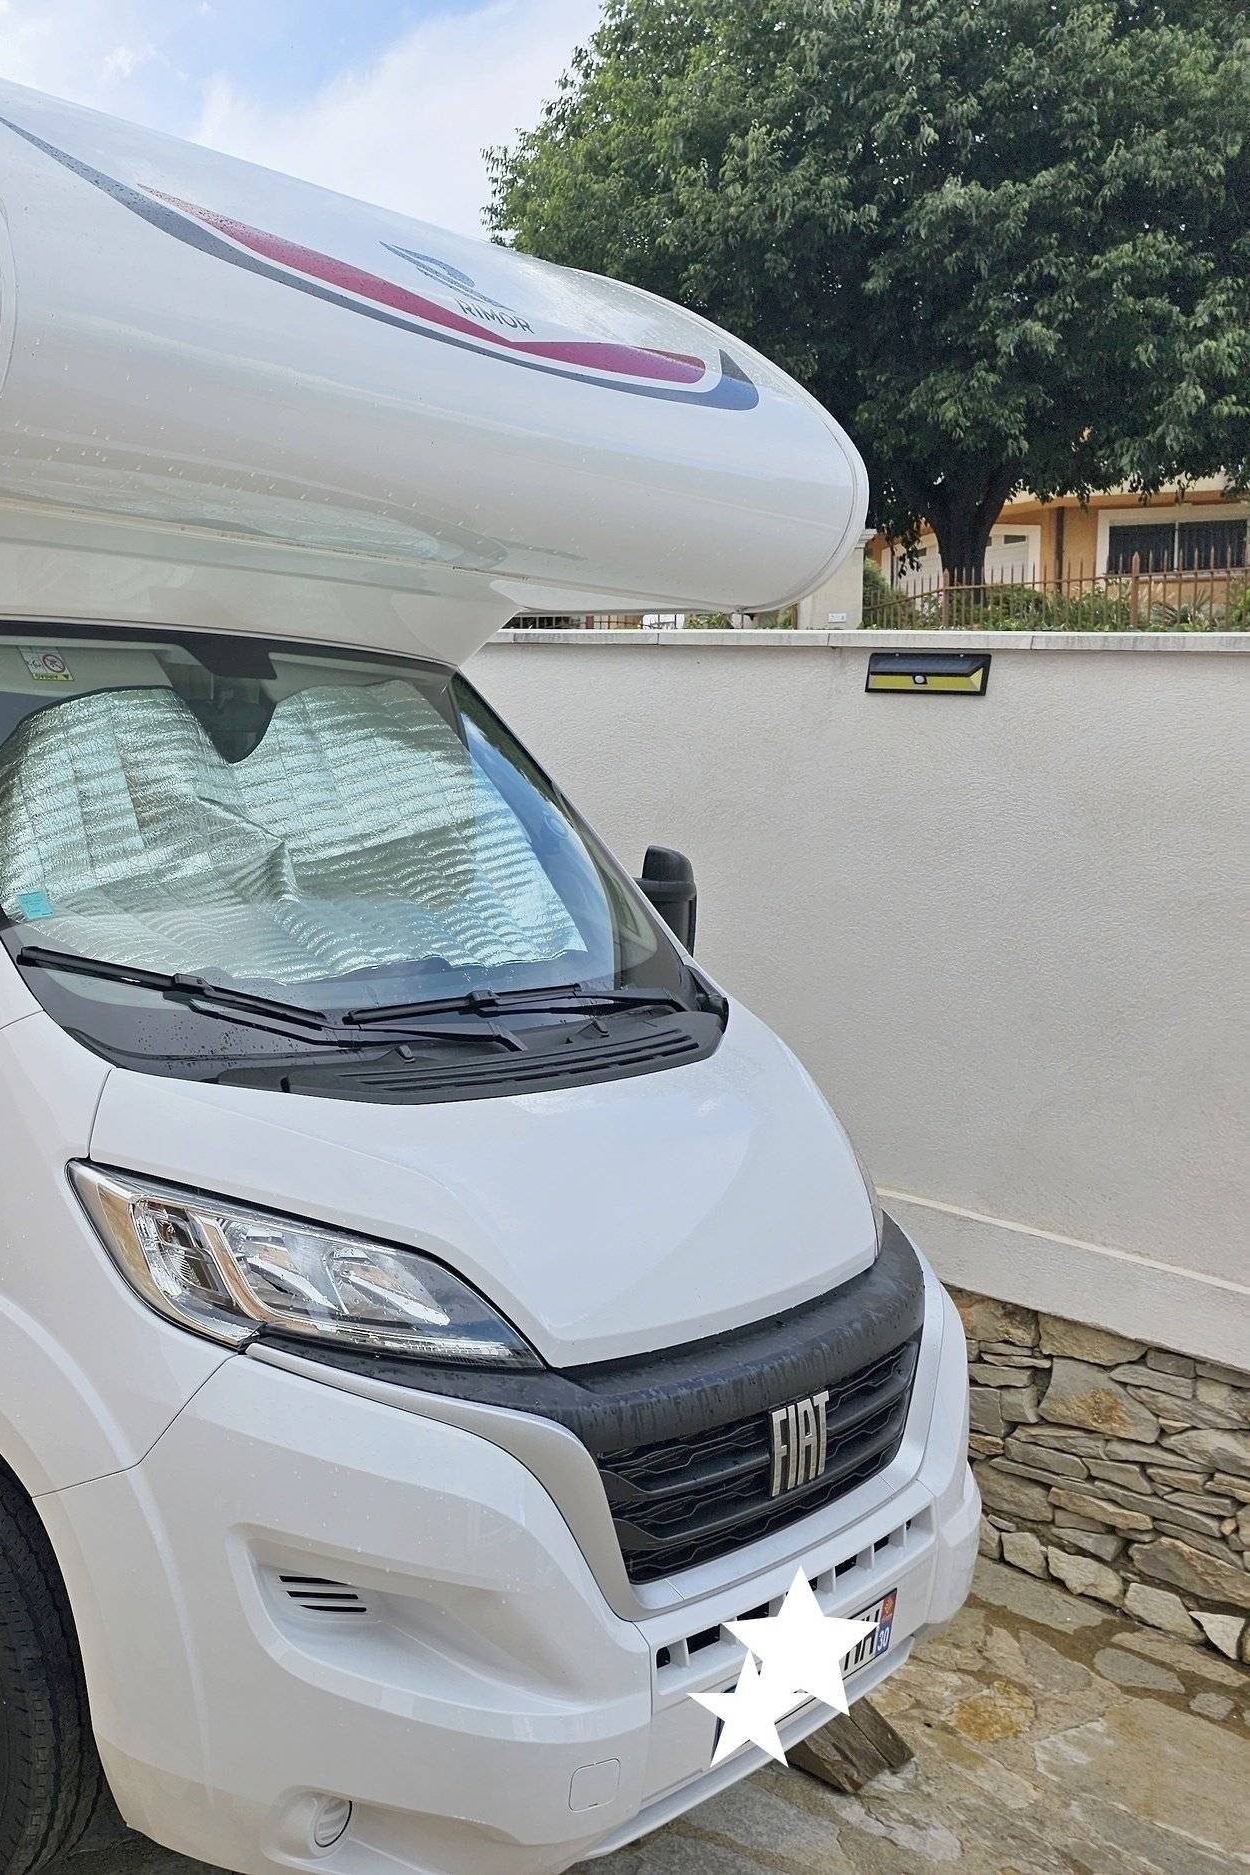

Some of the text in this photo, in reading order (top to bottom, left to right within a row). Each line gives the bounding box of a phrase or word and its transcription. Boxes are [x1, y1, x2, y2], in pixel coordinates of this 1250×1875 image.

[454, 298, 535, 334] RIMOR
[771, 1390, 830, 1497] FIAT
[877, 1626, 890, 1652] 30
